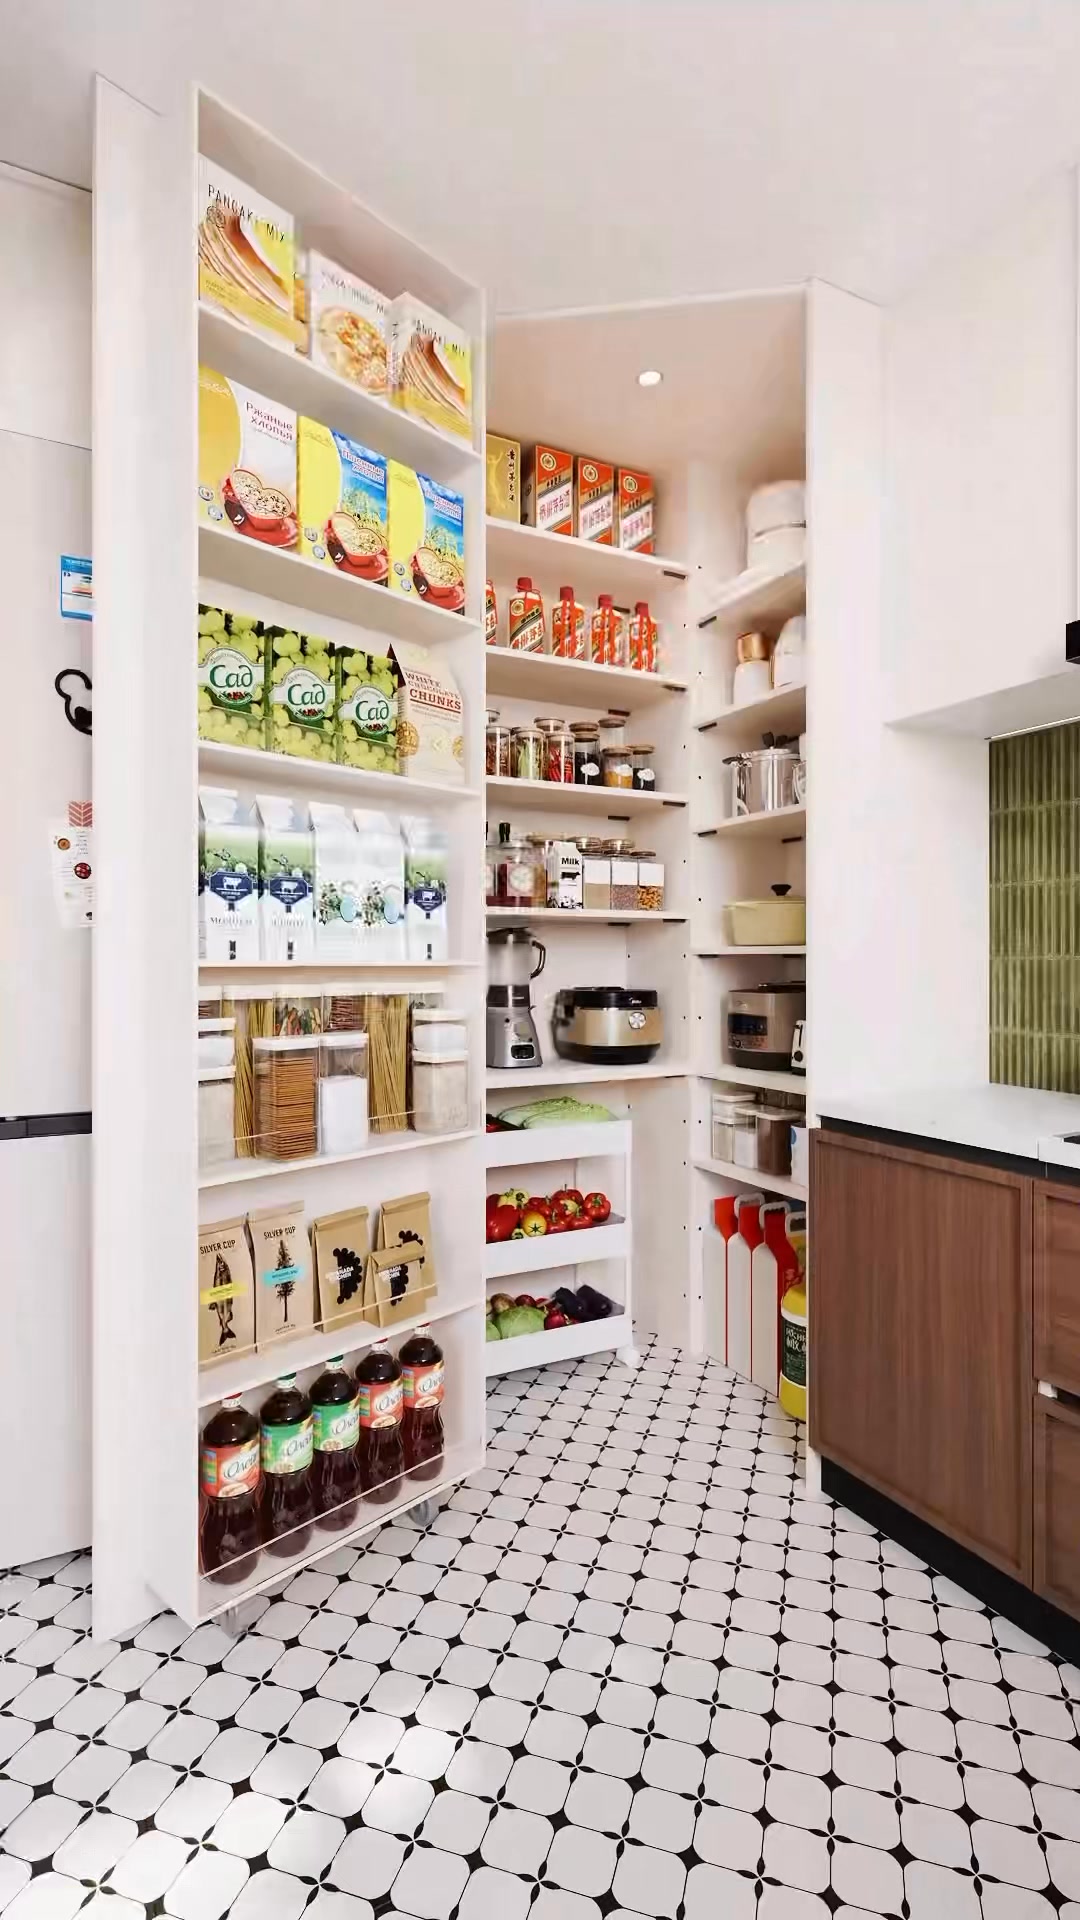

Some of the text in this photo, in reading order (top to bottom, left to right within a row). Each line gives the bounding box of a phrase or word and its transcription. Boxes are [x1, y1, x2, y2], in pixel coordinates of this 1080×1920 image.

[410, 688, 461, 710] CHUNKS
[561, 857, 579, 865] Milk
[264, 1226, 296, 1240] SILVER CUP
[200, 1240, 236, 1254] SILVER CUP
